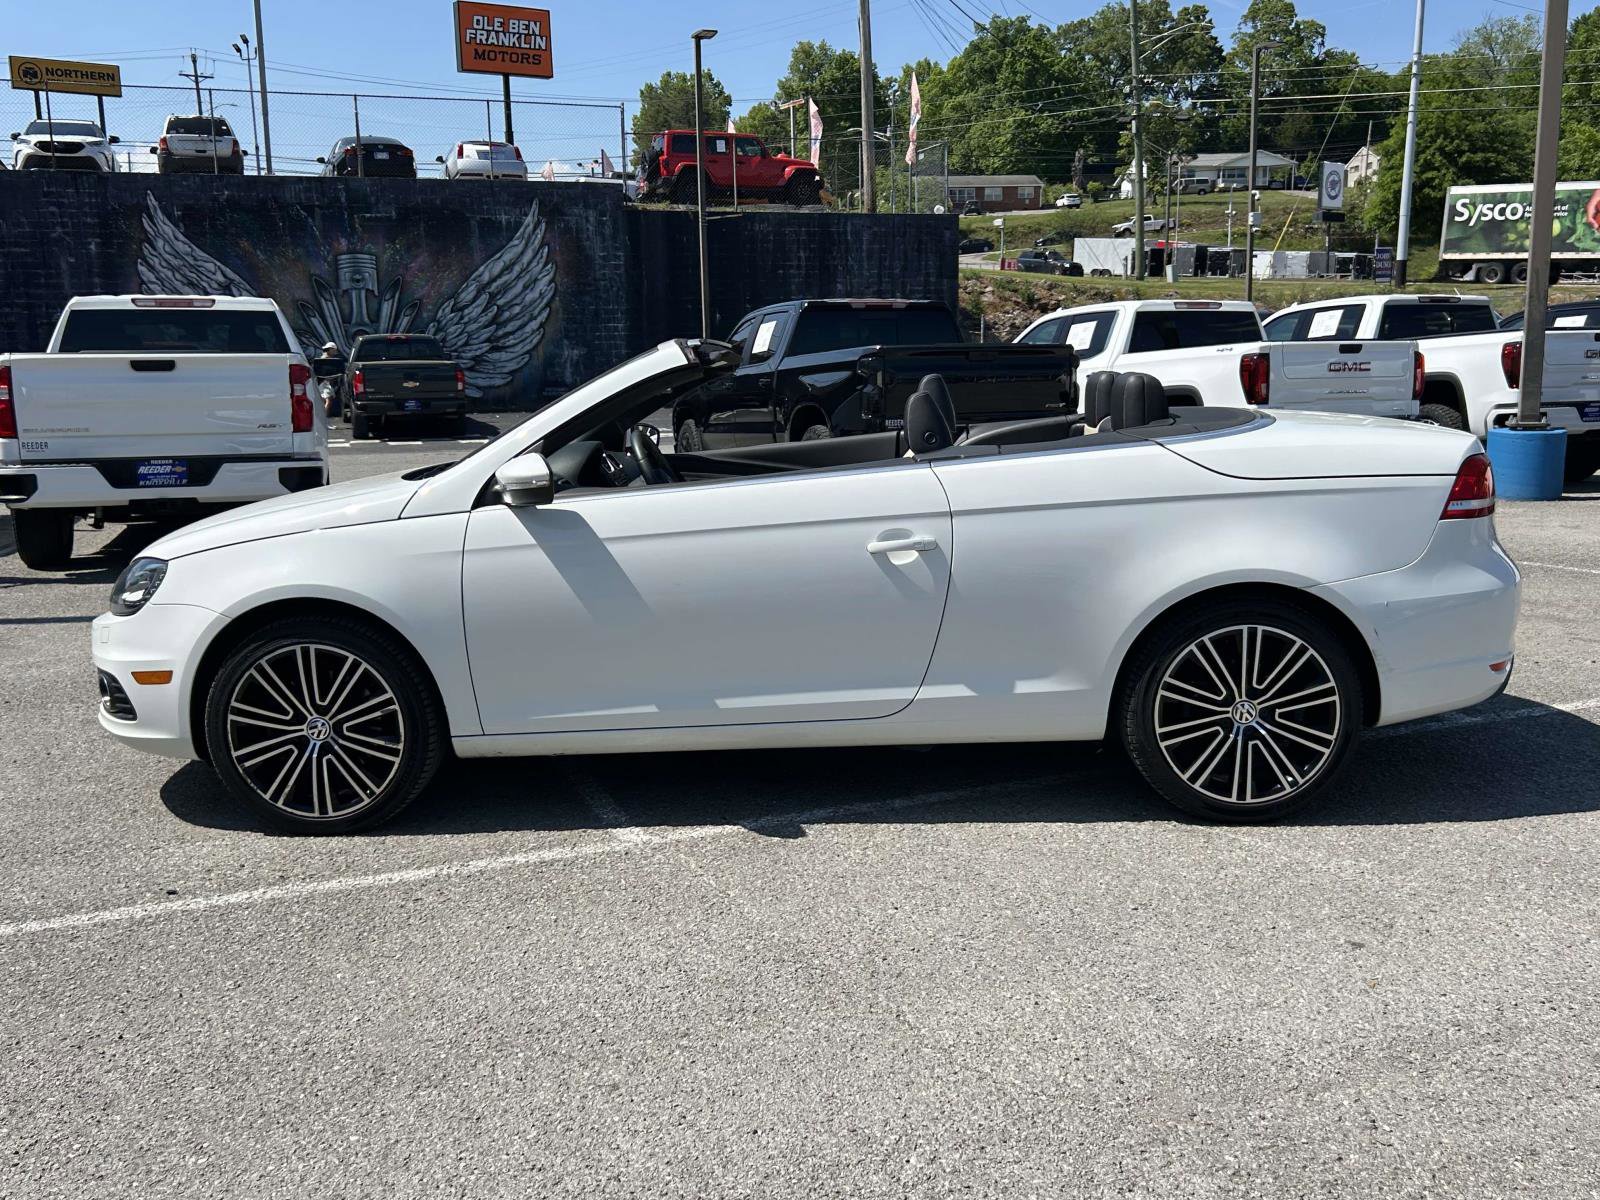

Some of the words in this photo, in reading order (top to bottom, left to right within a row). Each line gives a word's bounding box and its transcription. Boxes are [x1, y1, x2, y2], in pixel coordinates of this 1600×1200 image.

[472, 15, 504, 31] OLE
[508, 19, 541, 35] BEN
[465, 29, 547, 50] FRANKLIN
[473, 48, 542, 65] MOTORS
[45, 66, 116, 82] NORTHERN
[1328, 361, 1371, 372] GMC
[21, 441, 49, 450] REEDER
[138, 465, 172, 474] REEDER
